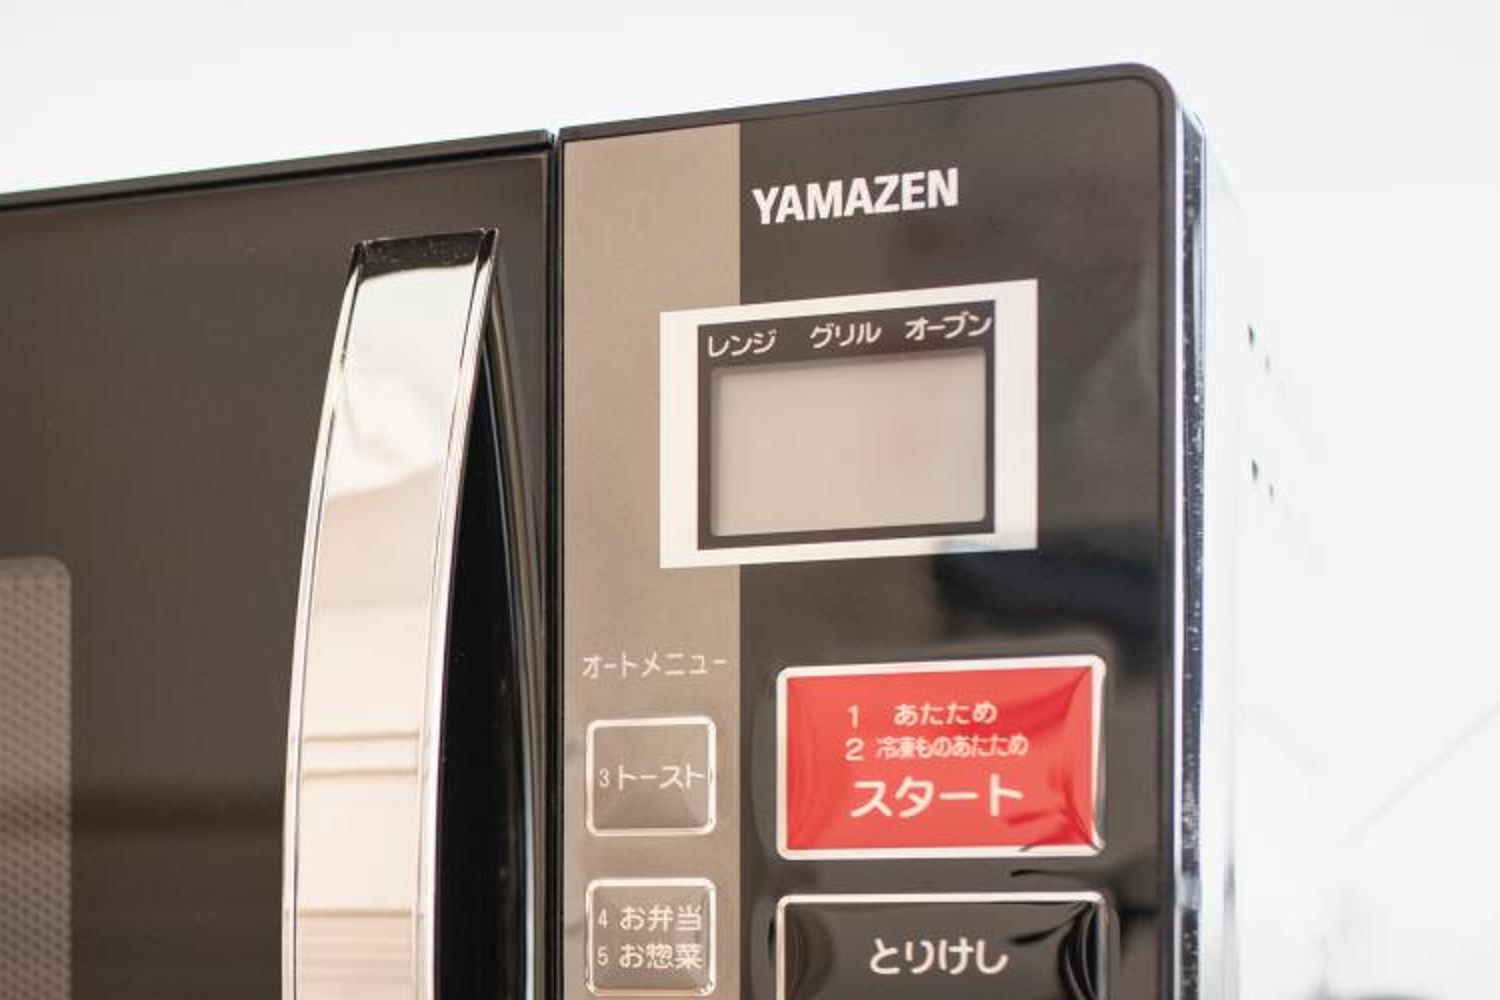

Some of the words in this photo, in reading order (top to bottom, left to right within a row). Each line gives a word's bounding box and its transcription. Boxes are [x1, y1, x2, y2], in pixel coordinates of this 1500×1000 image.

[751, 167, 959, 225] YAMAZEN
[707, 329, 777, 358] レンジ
[809, 321, 882, 349] グリル
[904, 310, 993, 342] オーブン
[582, 651, 727, 679] オートメニュー
[848, 704, 858, 728] 1
[894, 702, 997, 726] あたため
[845, 737, 864, 761] 2
[877, 735, 1028, 759] 冷凍ものあたため
[599, 767, 610, 788] 3
[618, 763, 706, 790] トースト
[851, 773, 1023, 818] スタート
[598, 908, 608, 929] 4
[620, 905, 702, 932] お弁当
[597, 946, 609, 966] 5
[620, 942, 703, 970] お惣菜
[870, 937, 1008, 975] とりけし
